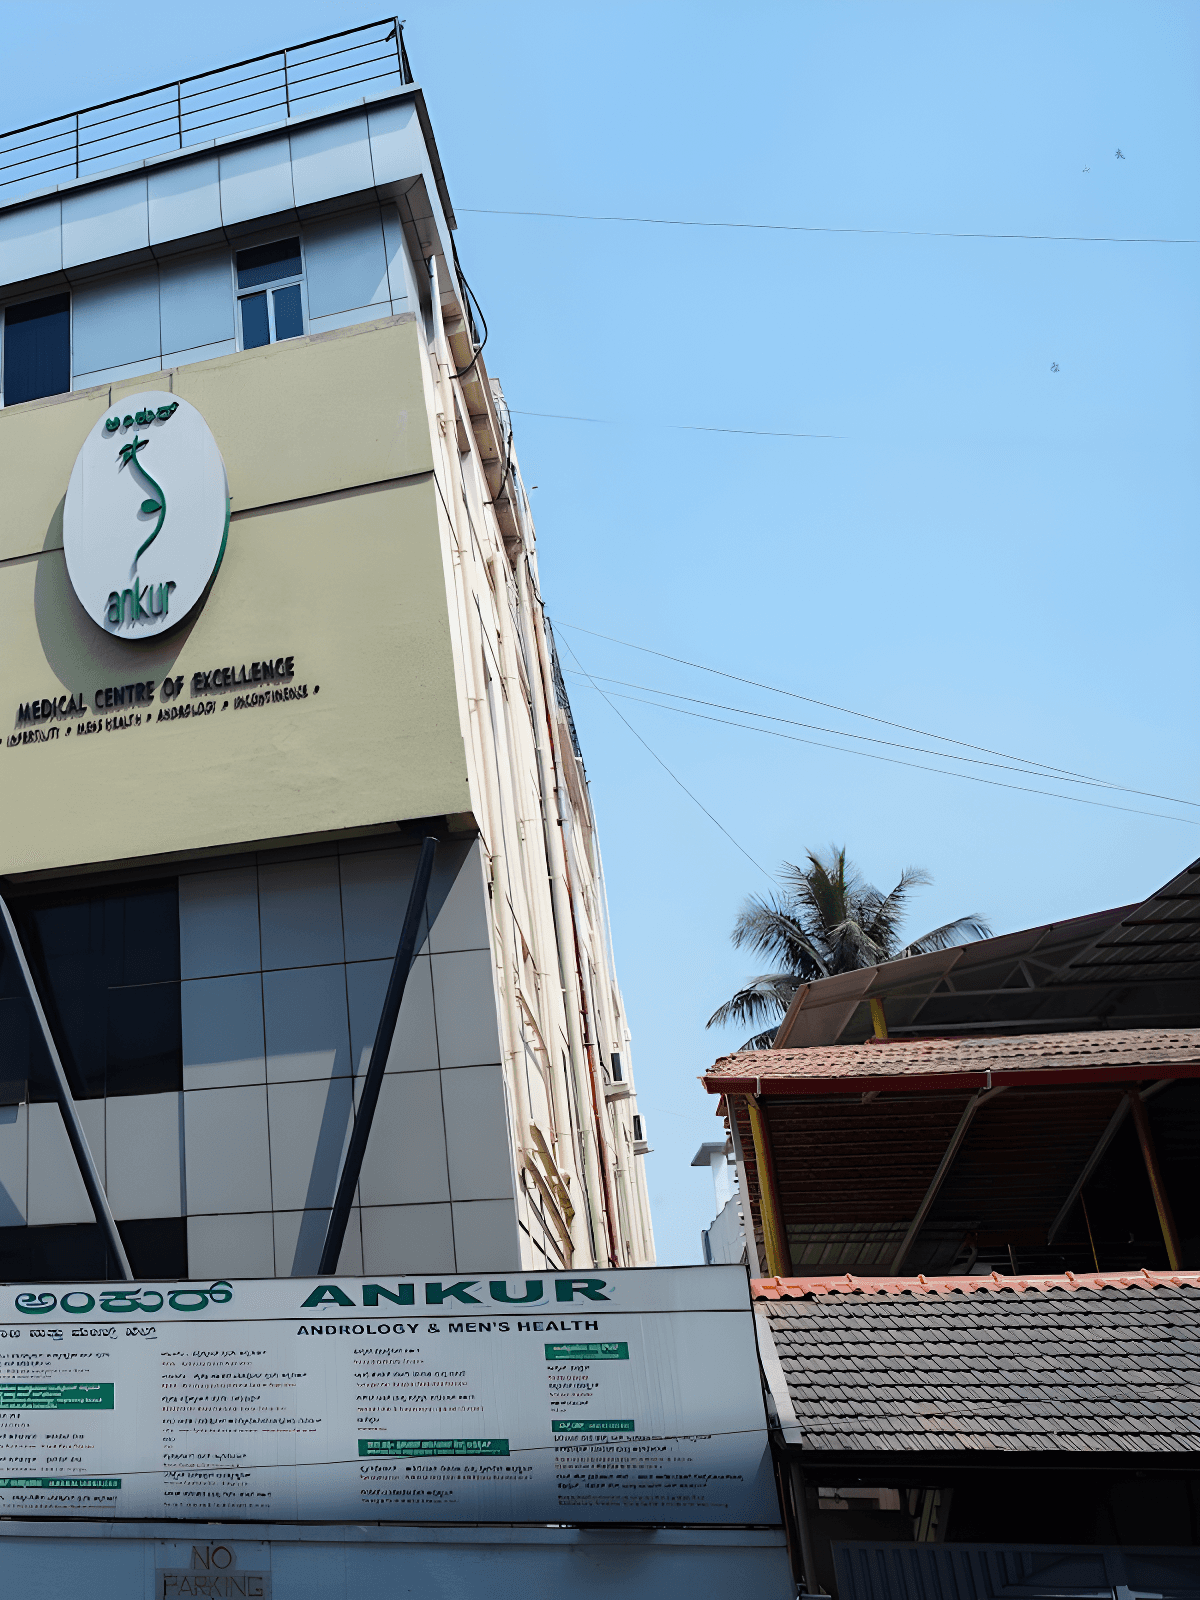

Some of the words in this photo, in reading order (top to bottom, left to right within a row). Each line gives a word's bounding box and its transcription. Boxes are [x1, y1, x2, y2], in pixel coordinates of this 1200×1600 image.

[106, 576, 177, 624] ankur
[17, 692, 88, 722] MEDICAL
[94, 680, 155, 709] CENTRE
[163, 675, 184, 697] OF
[193, 655, 295, 691] EXCELLENCE
[14, 1281, 234, 1315] ಅಂಕುರ್
[299, 1278, 612, 1308] ANKUR
[296, 1323, 420, 1337] ANDROLOGY
[427, 1322, 441, 1334] &
[448, 1321, 511, 1333] MEN'S
[517, 1320, 599, 1332] HEALTH
[192, 1545, 233, 1570] NO
[163, 1574, 264, 1598] PARKING
